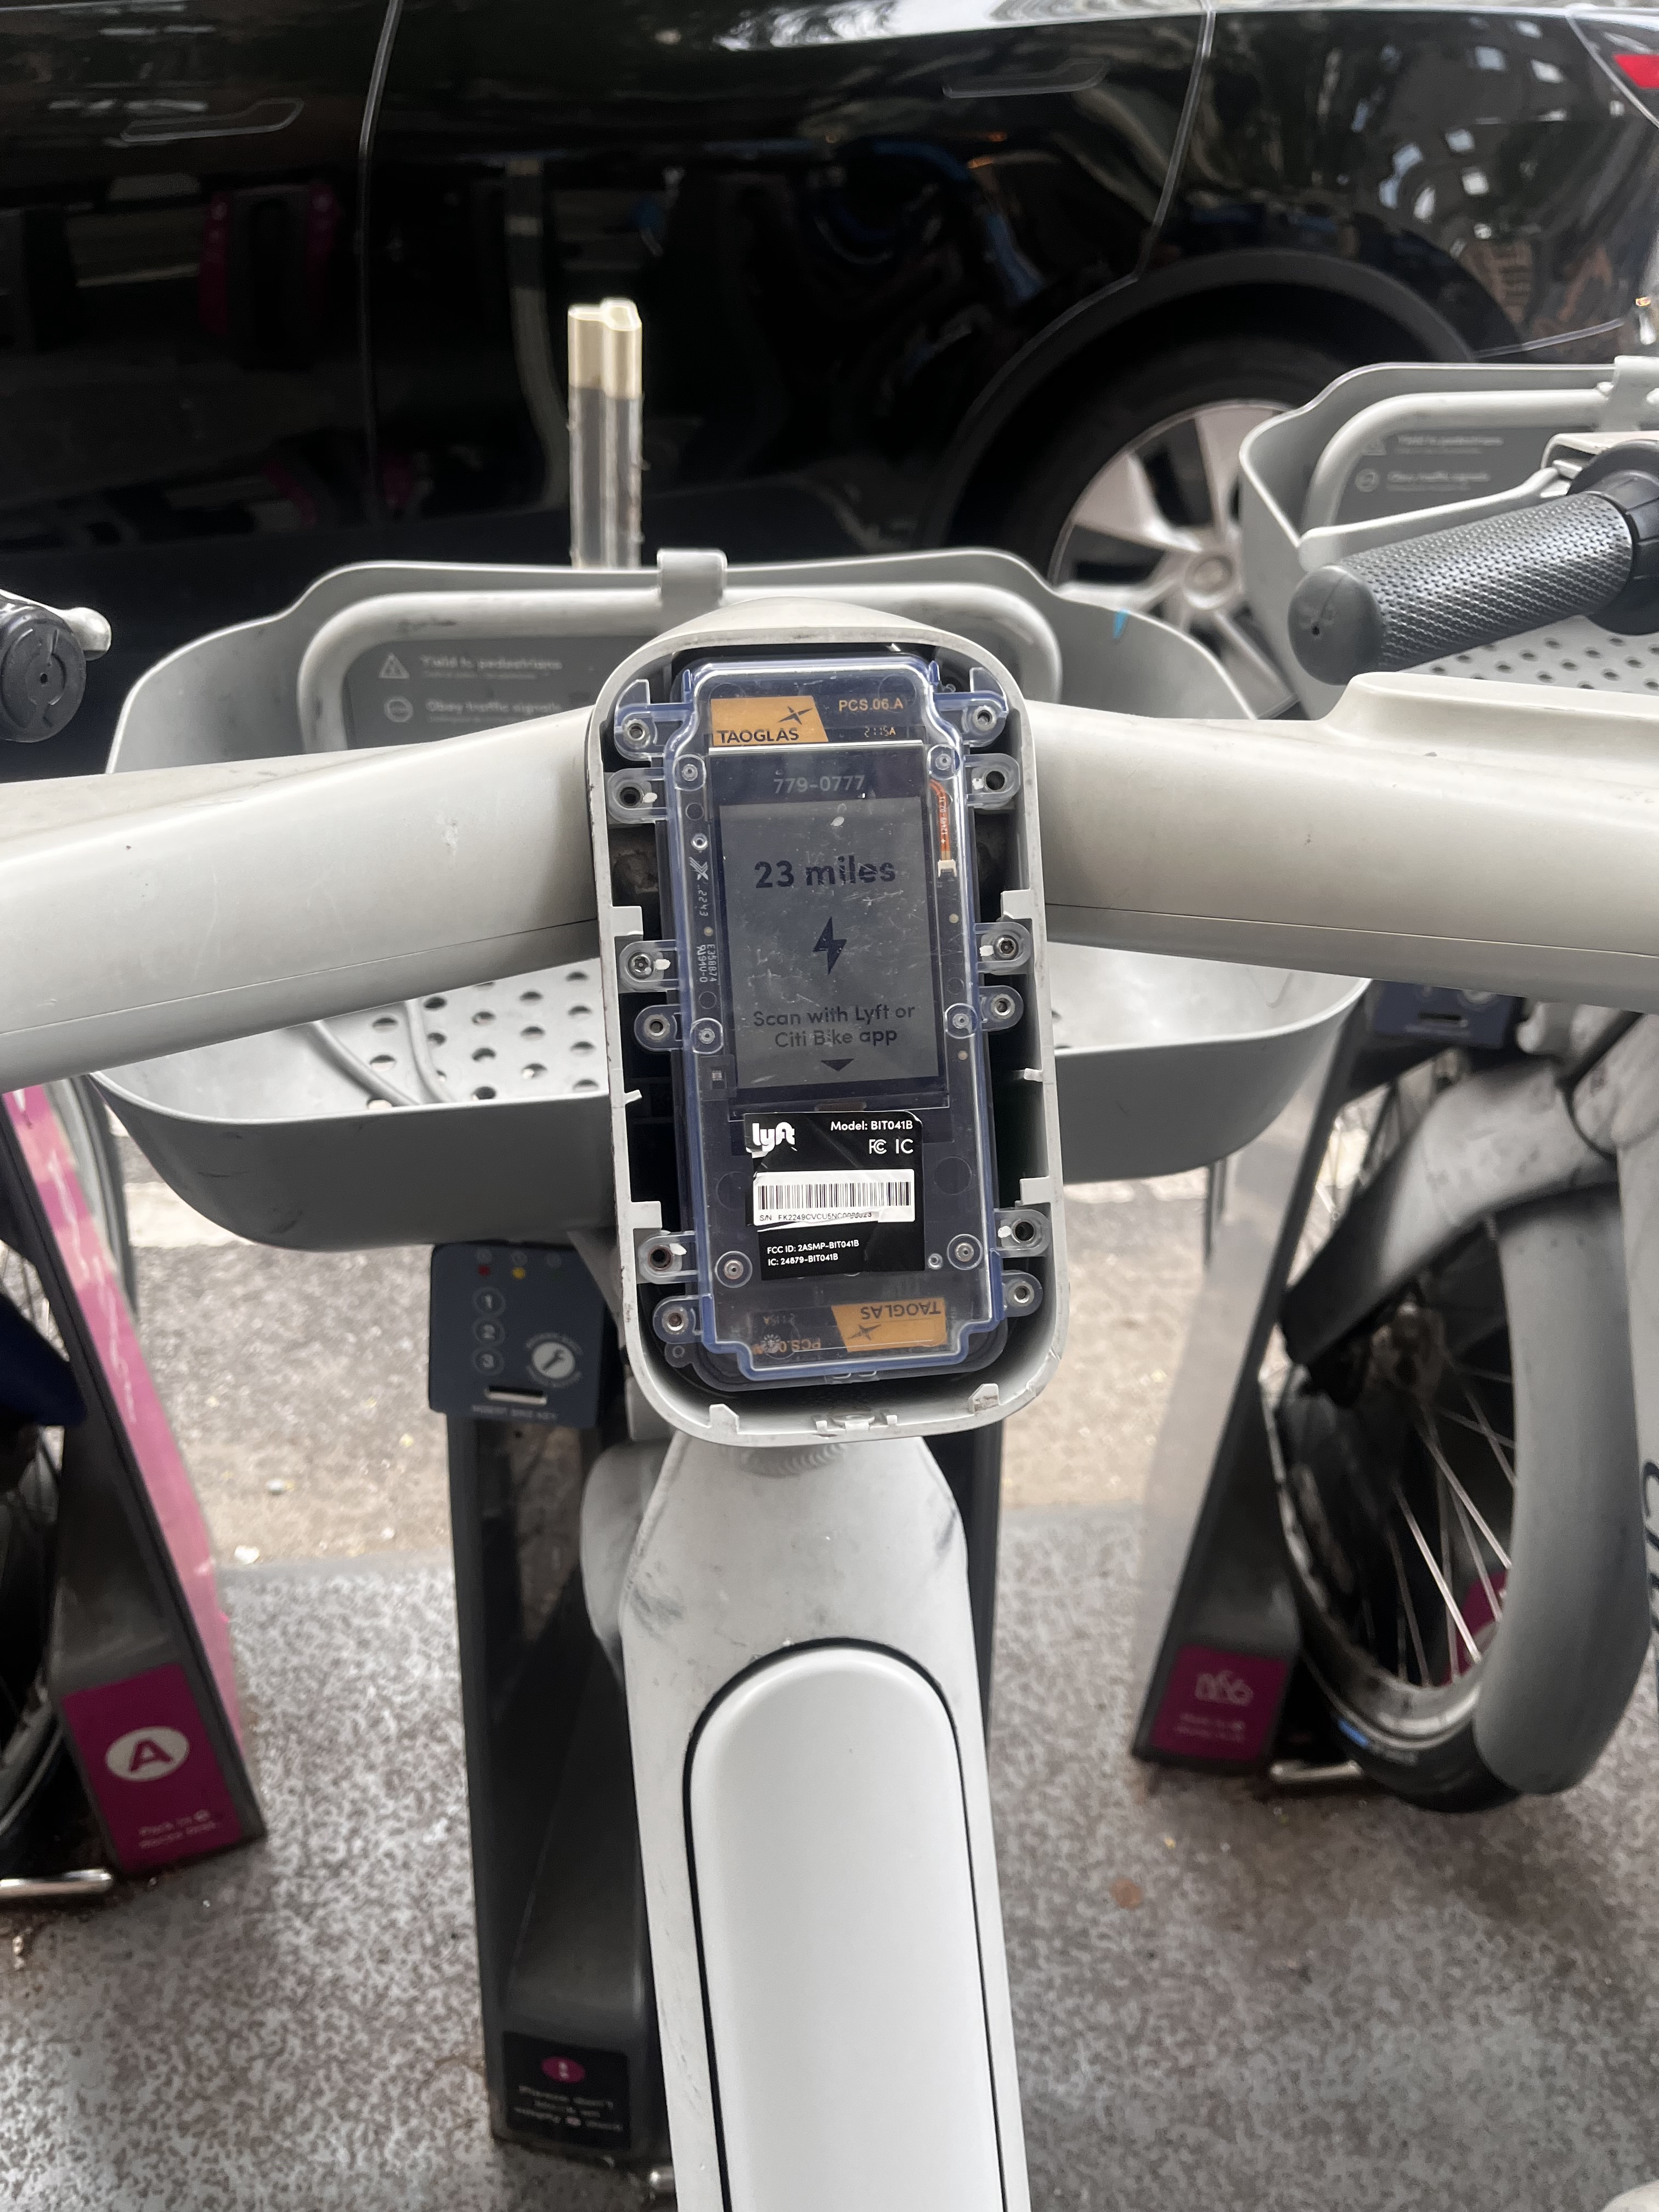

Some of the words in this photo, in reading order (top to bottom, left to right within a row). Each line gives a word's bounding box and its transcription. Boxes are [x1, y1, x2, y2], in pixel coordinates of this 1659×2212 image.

[717, 727, 799, 743] TAOGLAS
[773, 775, 865, 794] 779-0777
[754, 860, 794, 888] 23
[805, 855, 896, 886] miles
[753, 1011, 801, 1026] Scan
[807, 1006, 848, 1024] with
[855, 1003, 890, 1025] Lyft
[895, 1006, 915, 1018] or
[774, 1030, 806, 1048] Citi
[813, 1029, 853, 1045] Bike
[859, 1030, 898, 1046] app
[831, 1120, 868, 1131] Model:
[871, 1120, 913, 1130] BIT041B
[895, 1139, 913, 1154] IC
[767, 1246, 783, 1254] FCC
[798, 1239, 859, 1252] 2ASMP-BIT041B
[768, 1258, 779, 1266] IC:
[860, 1300, 941, 1320] TAOGLAS
[129, 1740, 172, 1771] A
